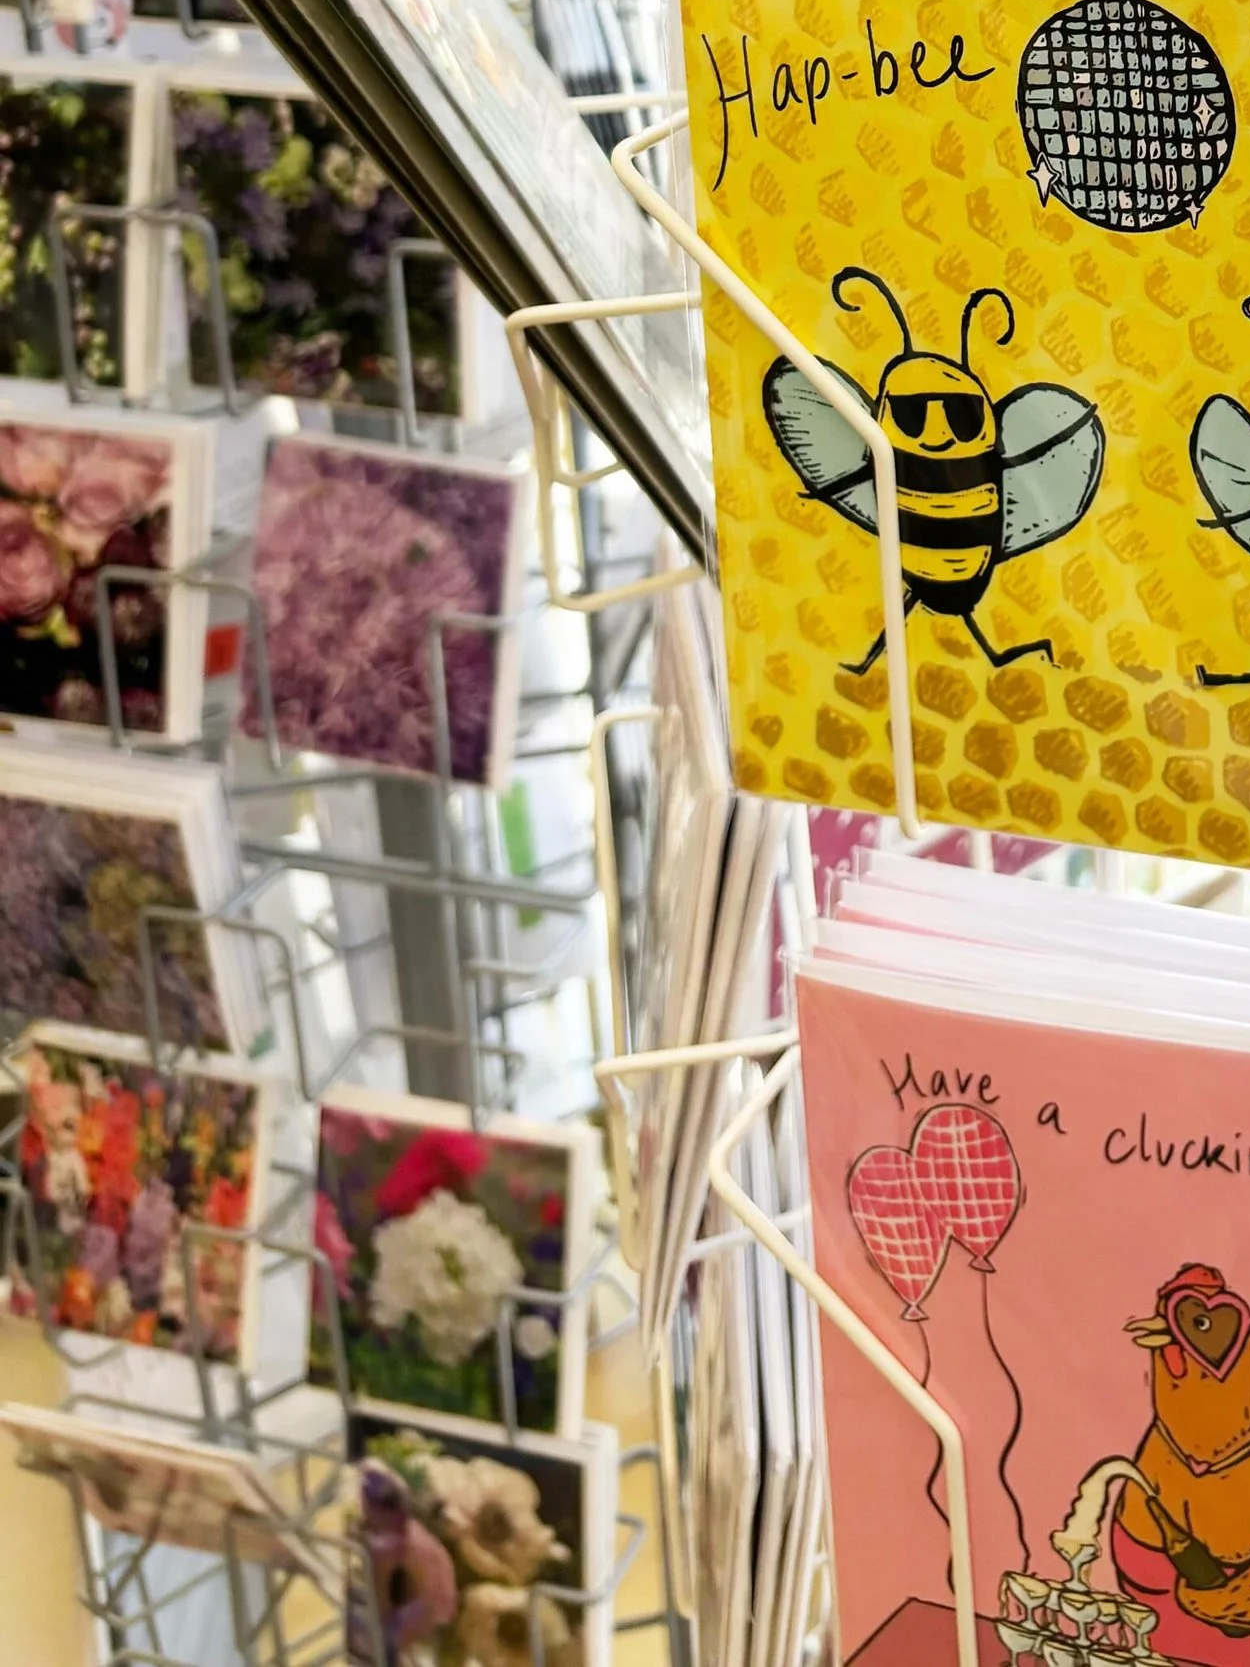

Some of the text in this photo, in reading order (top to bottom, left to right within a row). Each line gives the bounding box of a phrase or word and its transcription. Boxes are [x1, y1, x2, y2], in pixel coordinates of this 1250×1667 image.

[702, 19, 995, 192] Hap-bee
[881, 1053, 1000, 1110] Have
[1037, 1101, 1067, 1135] a
